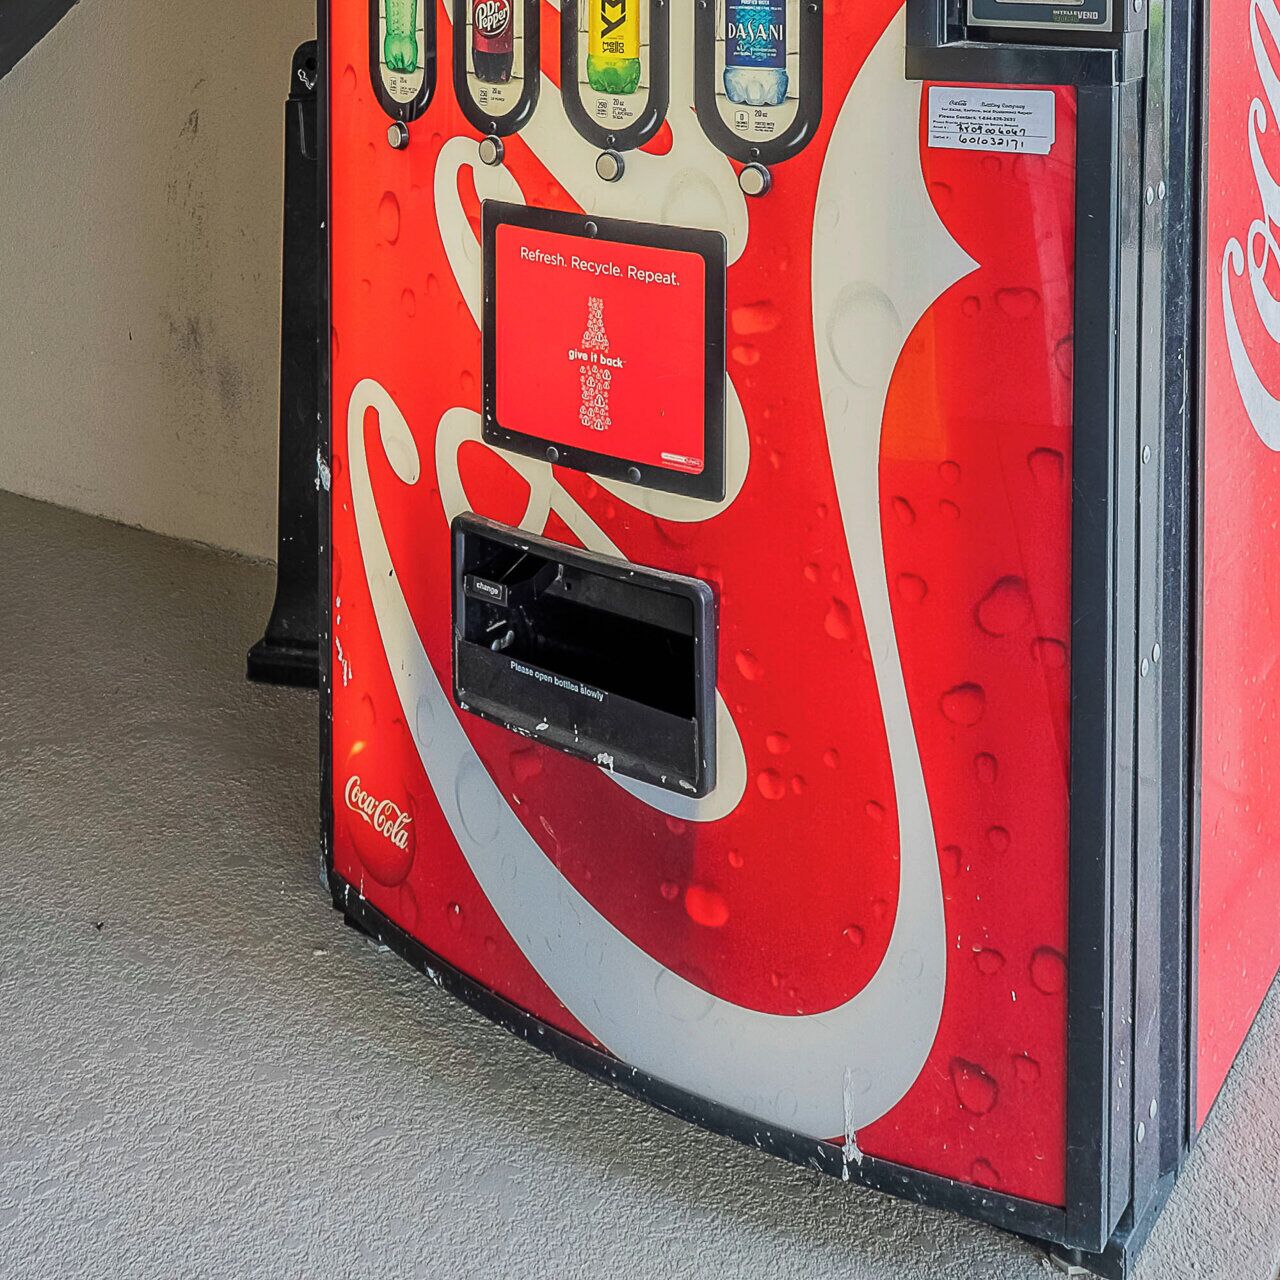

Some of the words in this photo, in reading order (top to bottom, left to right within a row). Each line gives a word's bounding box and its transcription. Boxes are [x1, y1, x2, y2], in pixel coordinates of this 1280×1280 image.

[478, 3, 509, 31] Pepper
[486, 0, 500, 17] Dr
[728, 19, 783, 43] DASANI
[613, 98, 620, 106] 20
[754, 109, 762, 118] 20
[520, 246, 567, 268] Refresh.
[571, 256, 623, 277] Recycle.
[627, 265, 680, 286] Repeat.
[568, 348, 588, 363] give
[590, 351, 598, 364] it
[599, 354, 624, 368] back
[476, 581, 499, 595] change
[510, 660, 534, 677] Please
[534, 670, 553, 683] open
[553, 676, 579, 693] bottles
[579, 684, 604, 702] slowly
[345, 775, 412, 850] Coca-Cola
